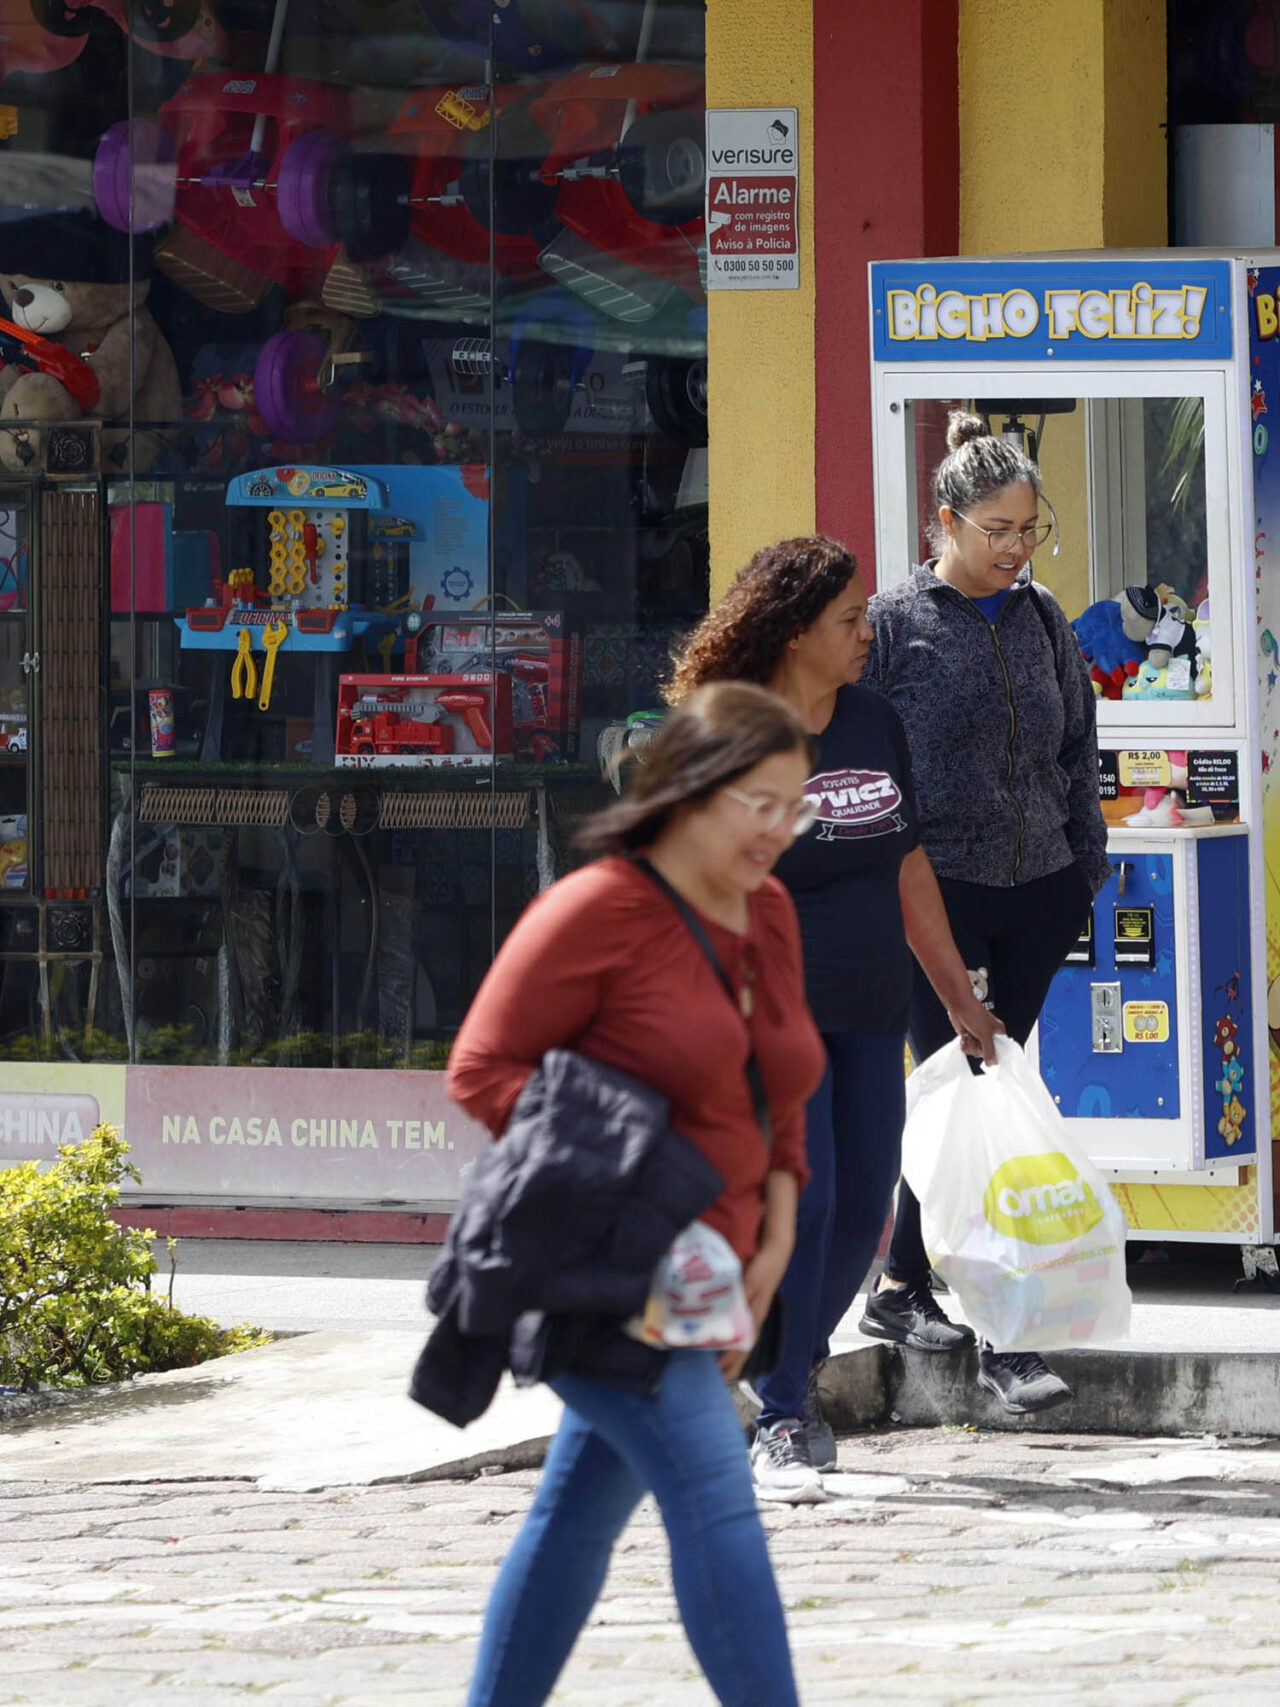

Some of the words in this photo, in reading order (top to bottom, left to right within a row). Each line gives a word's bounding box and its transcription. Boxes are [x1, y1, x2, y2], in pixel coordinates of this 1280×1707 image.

[711, 149, 793, 164] verisure
[714, 181, 791, 204] Alarme
[735, 212, 753, 220] com
[756, 211, 790, 223] registro
[735, 222, 746, 231] de
[750, 222, 790, 233] imagens
[716, 239, 744, 249] Aviso
[746, 238, 753, 249] à
[756, 238, 790, 249] Polícia
[723, 260, 746, 271] 0300
[748, 260, 760, 271] 50
[762, 260, 774, 271] 50
[776, 259, 793, 271] 500
[1128, 751, 1140, 760] R$
[1142, 751, 1161, 761] 2,00
[822, 776, 859, 788] SORVETES
[831, 801, 882, 818] QUALIDADE
[162, 1115, 201, 1144] NA
[209, 1116, 282, 1146] CASA
[290, 1118, 378, 1149] CHINA
[386, 1120, 455, 1150] TEM.
